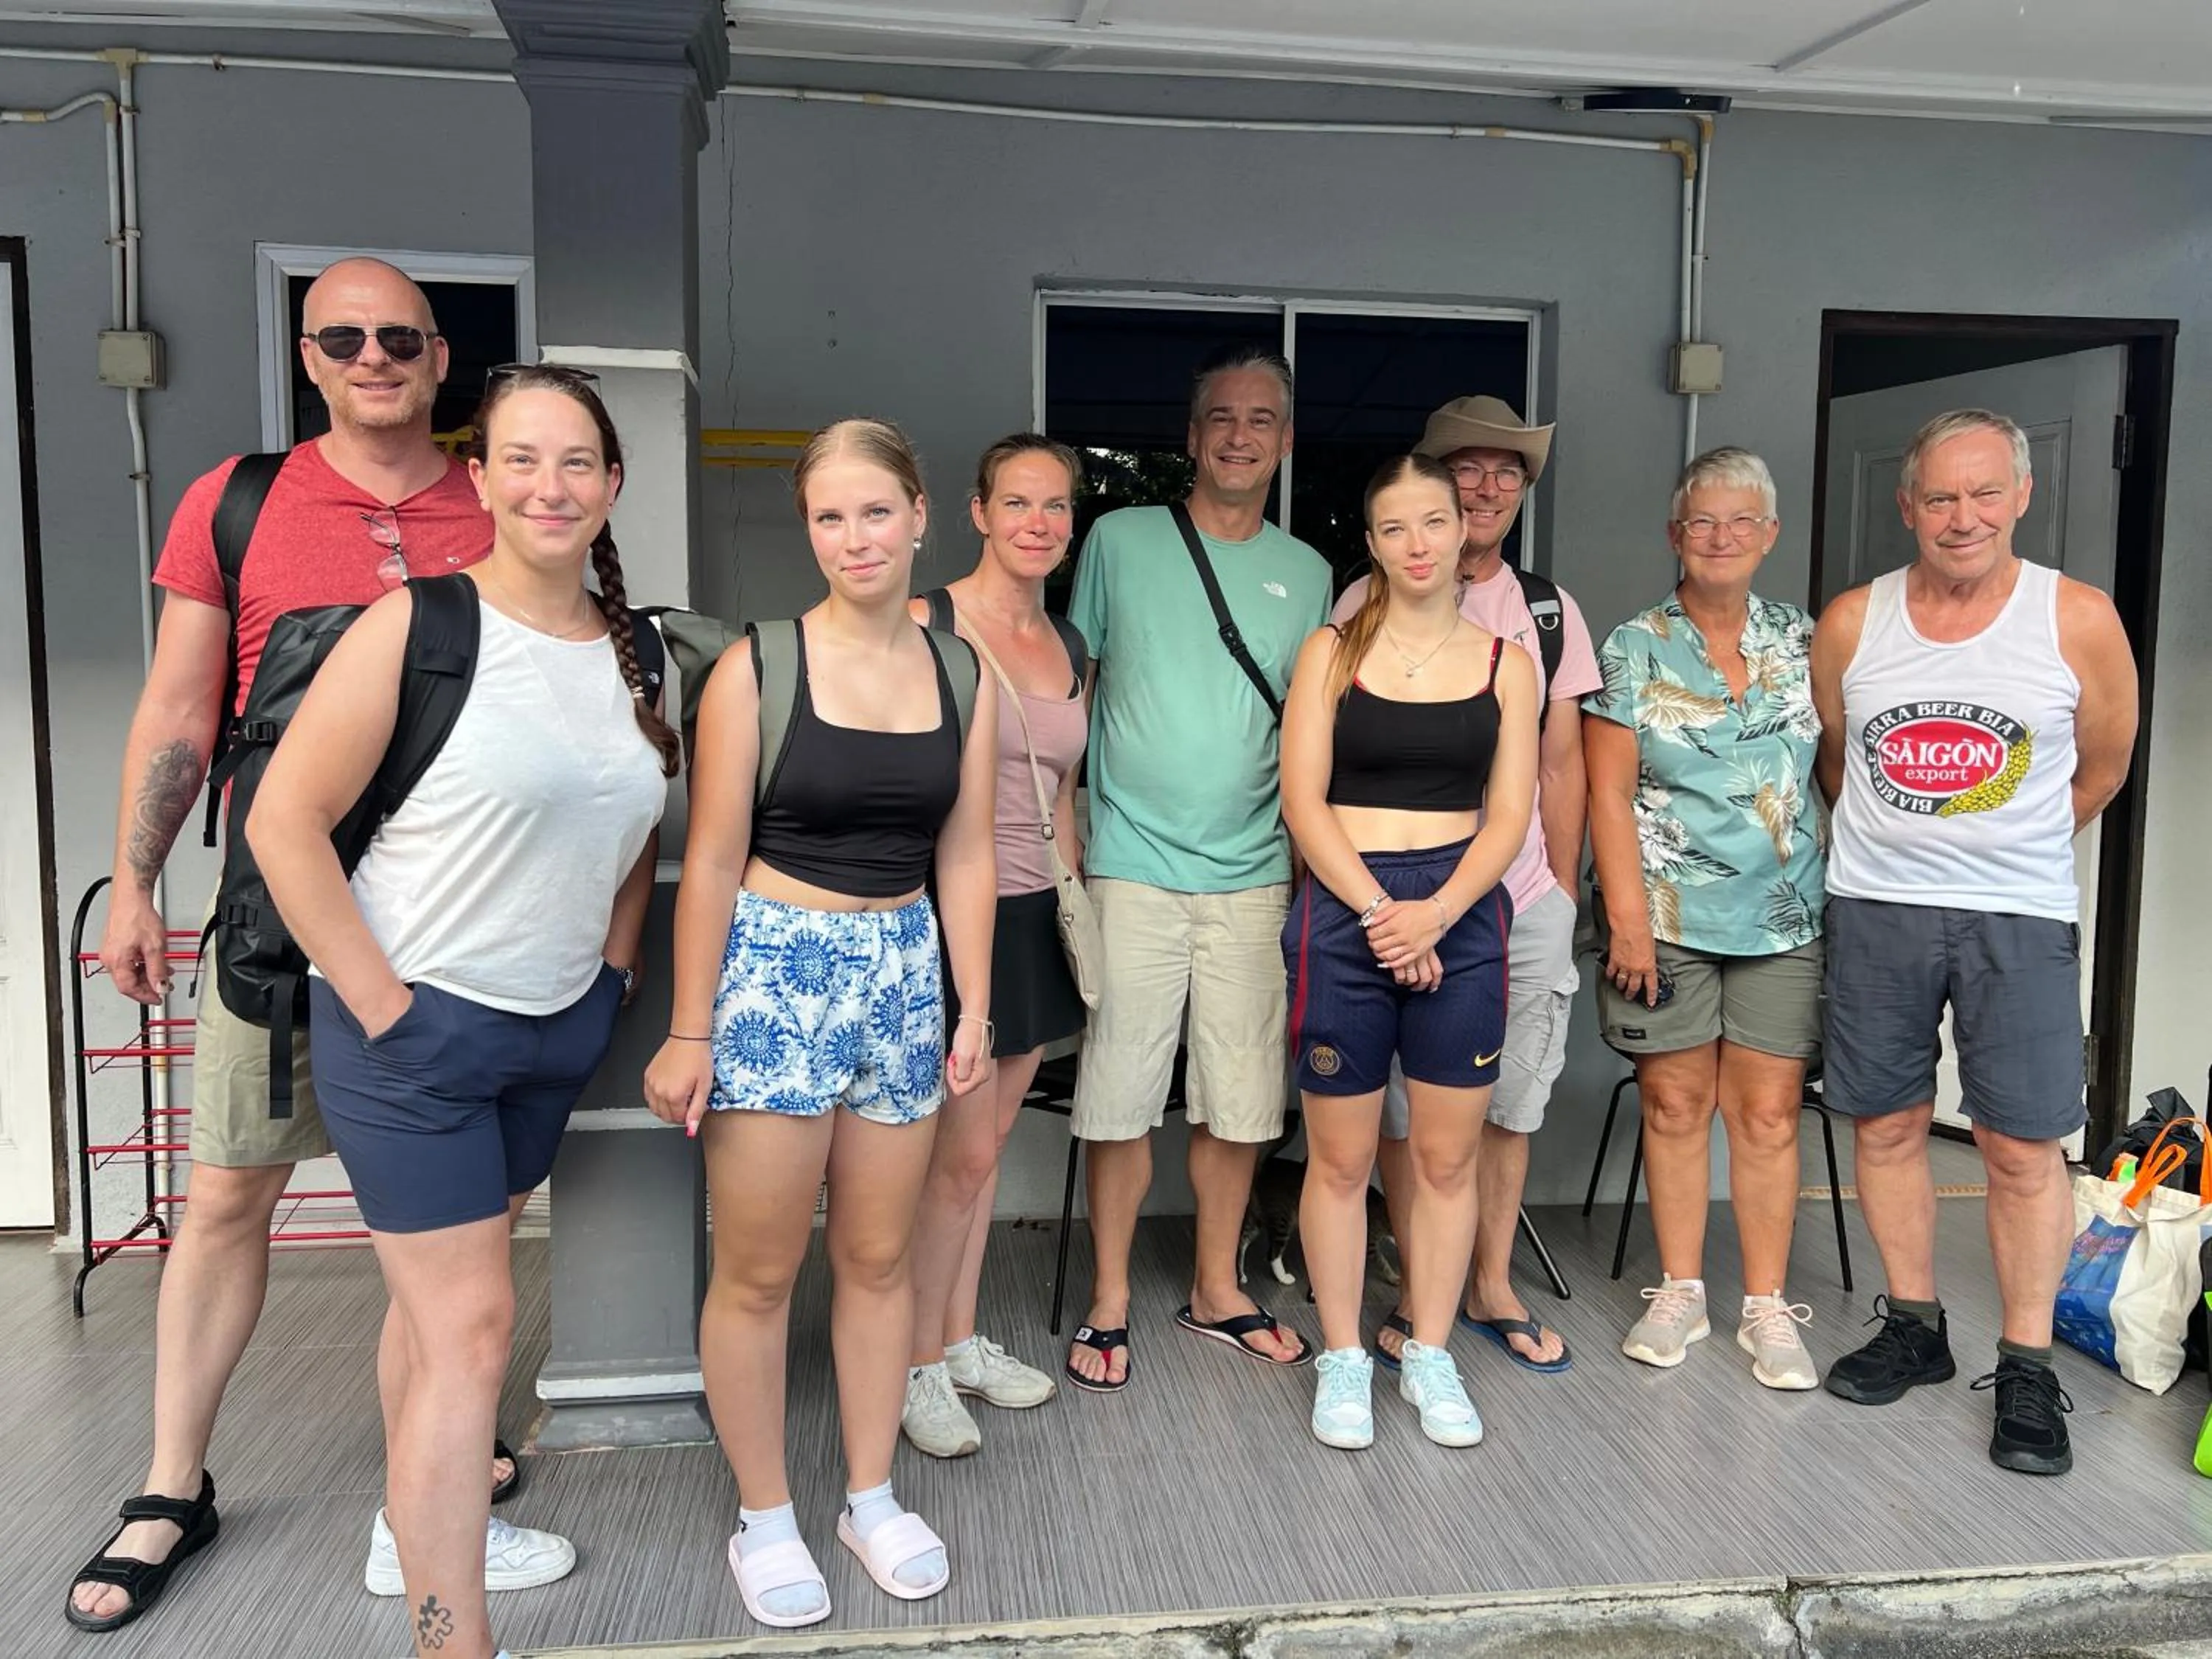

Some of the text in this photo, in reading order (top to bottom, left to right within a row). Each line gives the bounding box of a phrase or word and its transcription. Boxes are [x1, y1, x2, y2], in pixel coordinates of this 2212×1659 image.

[1917, 702, 1974, 719] BEER
[1978, 709, 2016, 737] BIA
[1905, 768, 1969, 785] export
[1899, 794, 1933, 812] BIA
